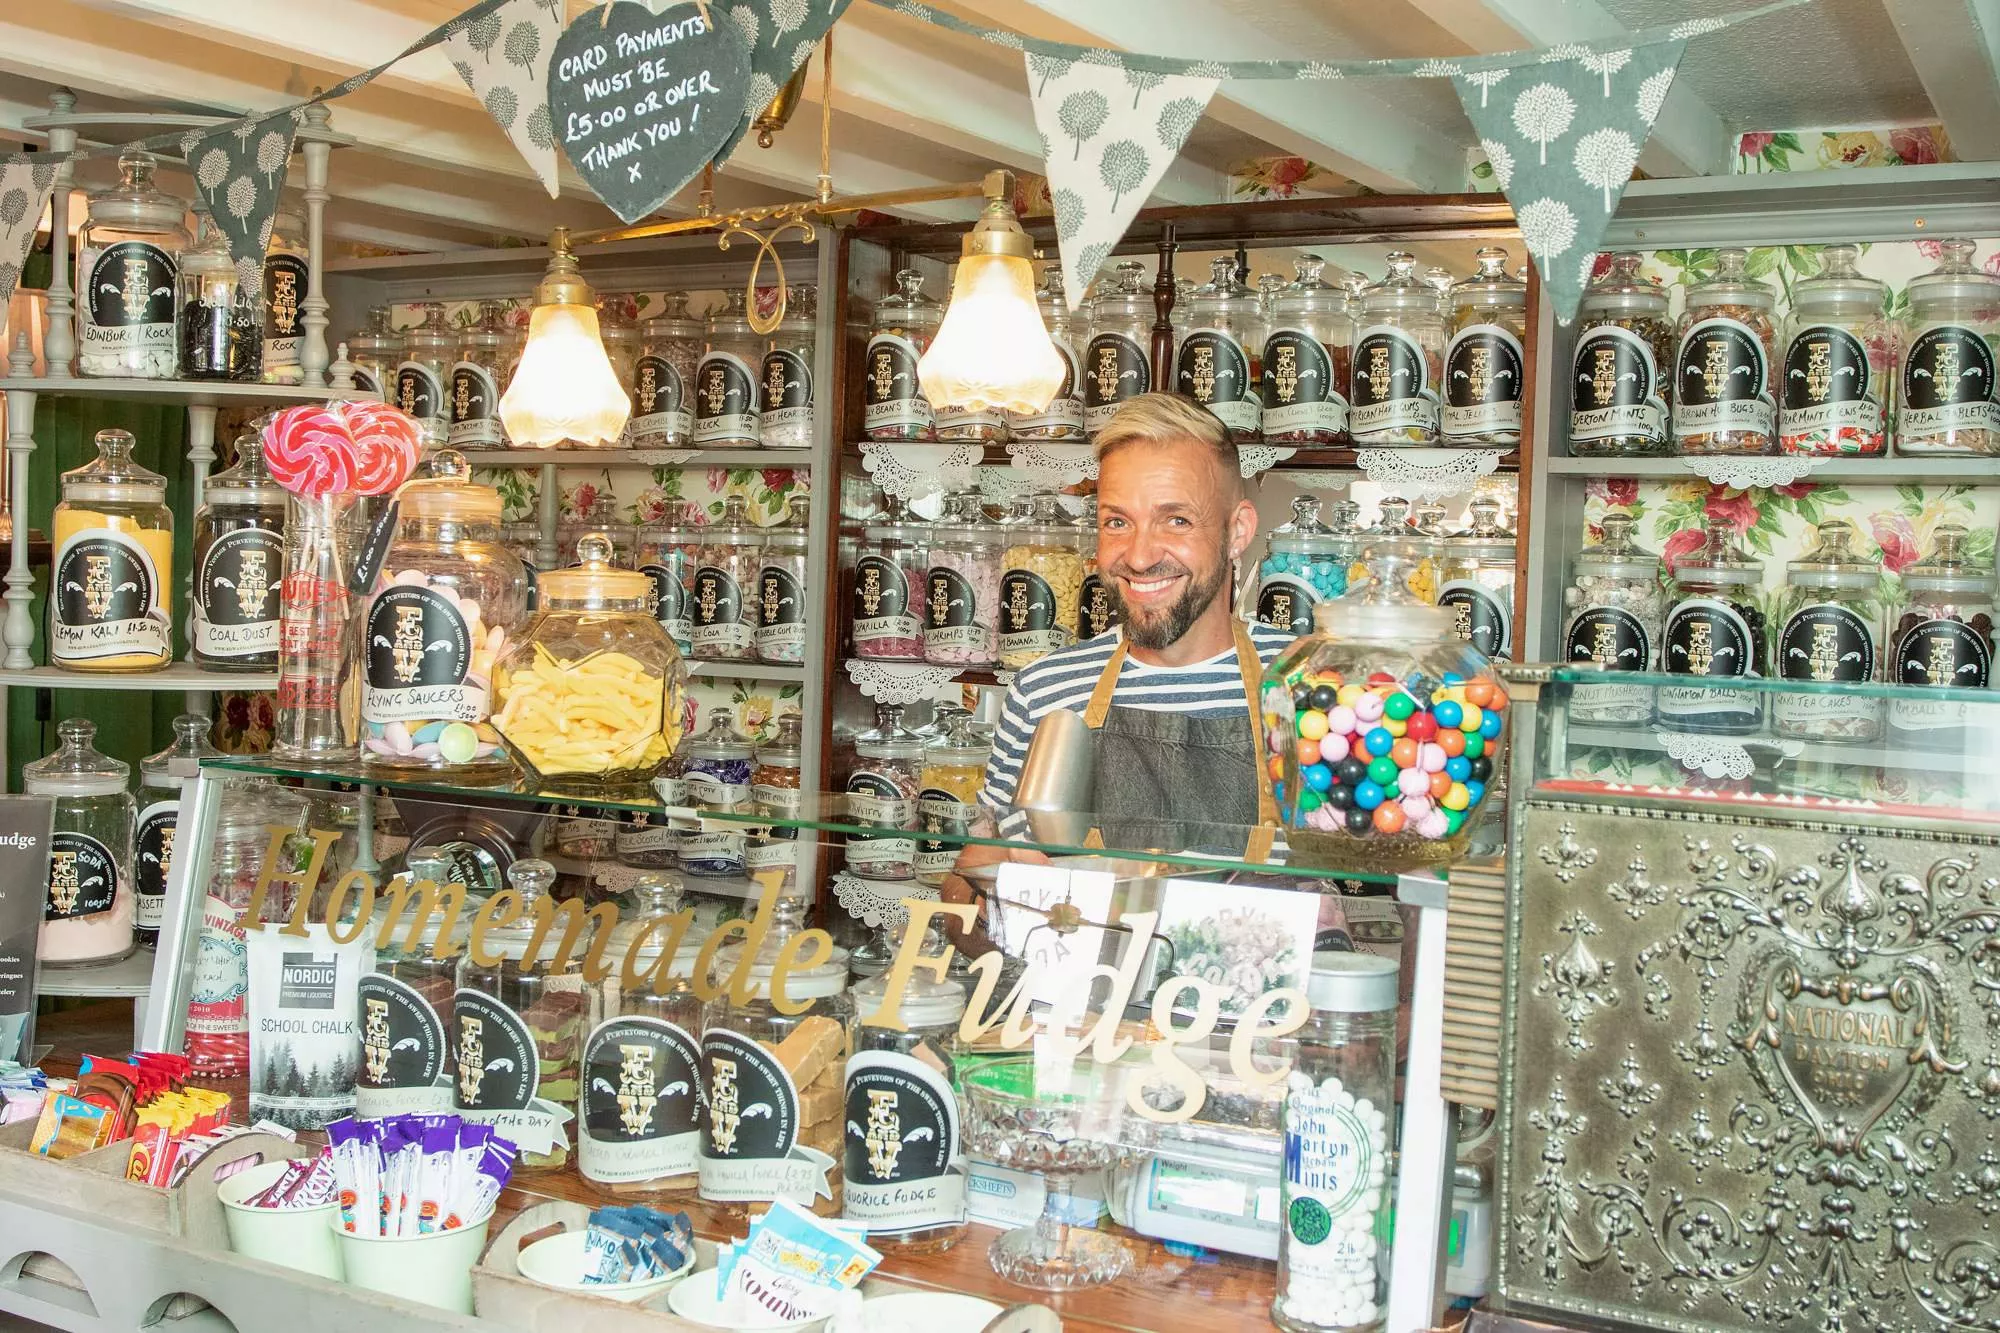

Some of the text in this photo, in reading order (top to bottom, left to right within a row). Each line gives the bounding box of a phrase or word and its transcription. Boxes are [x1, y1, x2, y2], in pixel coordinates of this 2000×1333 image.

[559, 16, 706, 82] CARD PAYMENTS
[583, 58, 670, 102] MUST BE
[565, 70, 720, 143] £5.00 OR OVER
[581, 133, 641, 171] THANK
[638, 117, 681, 147] YOU
[86, 326, 141, 343] EDINBUR
[1573, 412, 1608, 426] EVERTON
[1904, 412, 1942, 428] HERBAL
[1945, 406, 1988, 421] TBLETS
[209, 626, 272, 642] COAL DUST
[367, 689, 464, 708] FLYING SAUCERS
[0, 832, 36, 849] udge
[0, 955, 20, 963] ookies
[0, 971, 23, 981] eringues
[237, 824, 1311, 1124] Homemade Fudge
[283, 968, 335, 984] NORDIC
[213, 1023, 239, 1031] SWEETS
[261, 1018, 353, 1035] SCHOOL CHALK
[1783, 1003, 1907, 1048] NATIONAL
[1795, 1041, 1890, 1071] DAYTON
[528, 1115, 552, 1127] DAY
[1161, 1160, 1187, 1171] Weight
[895, 1187, 936, 1203] FUDGE
